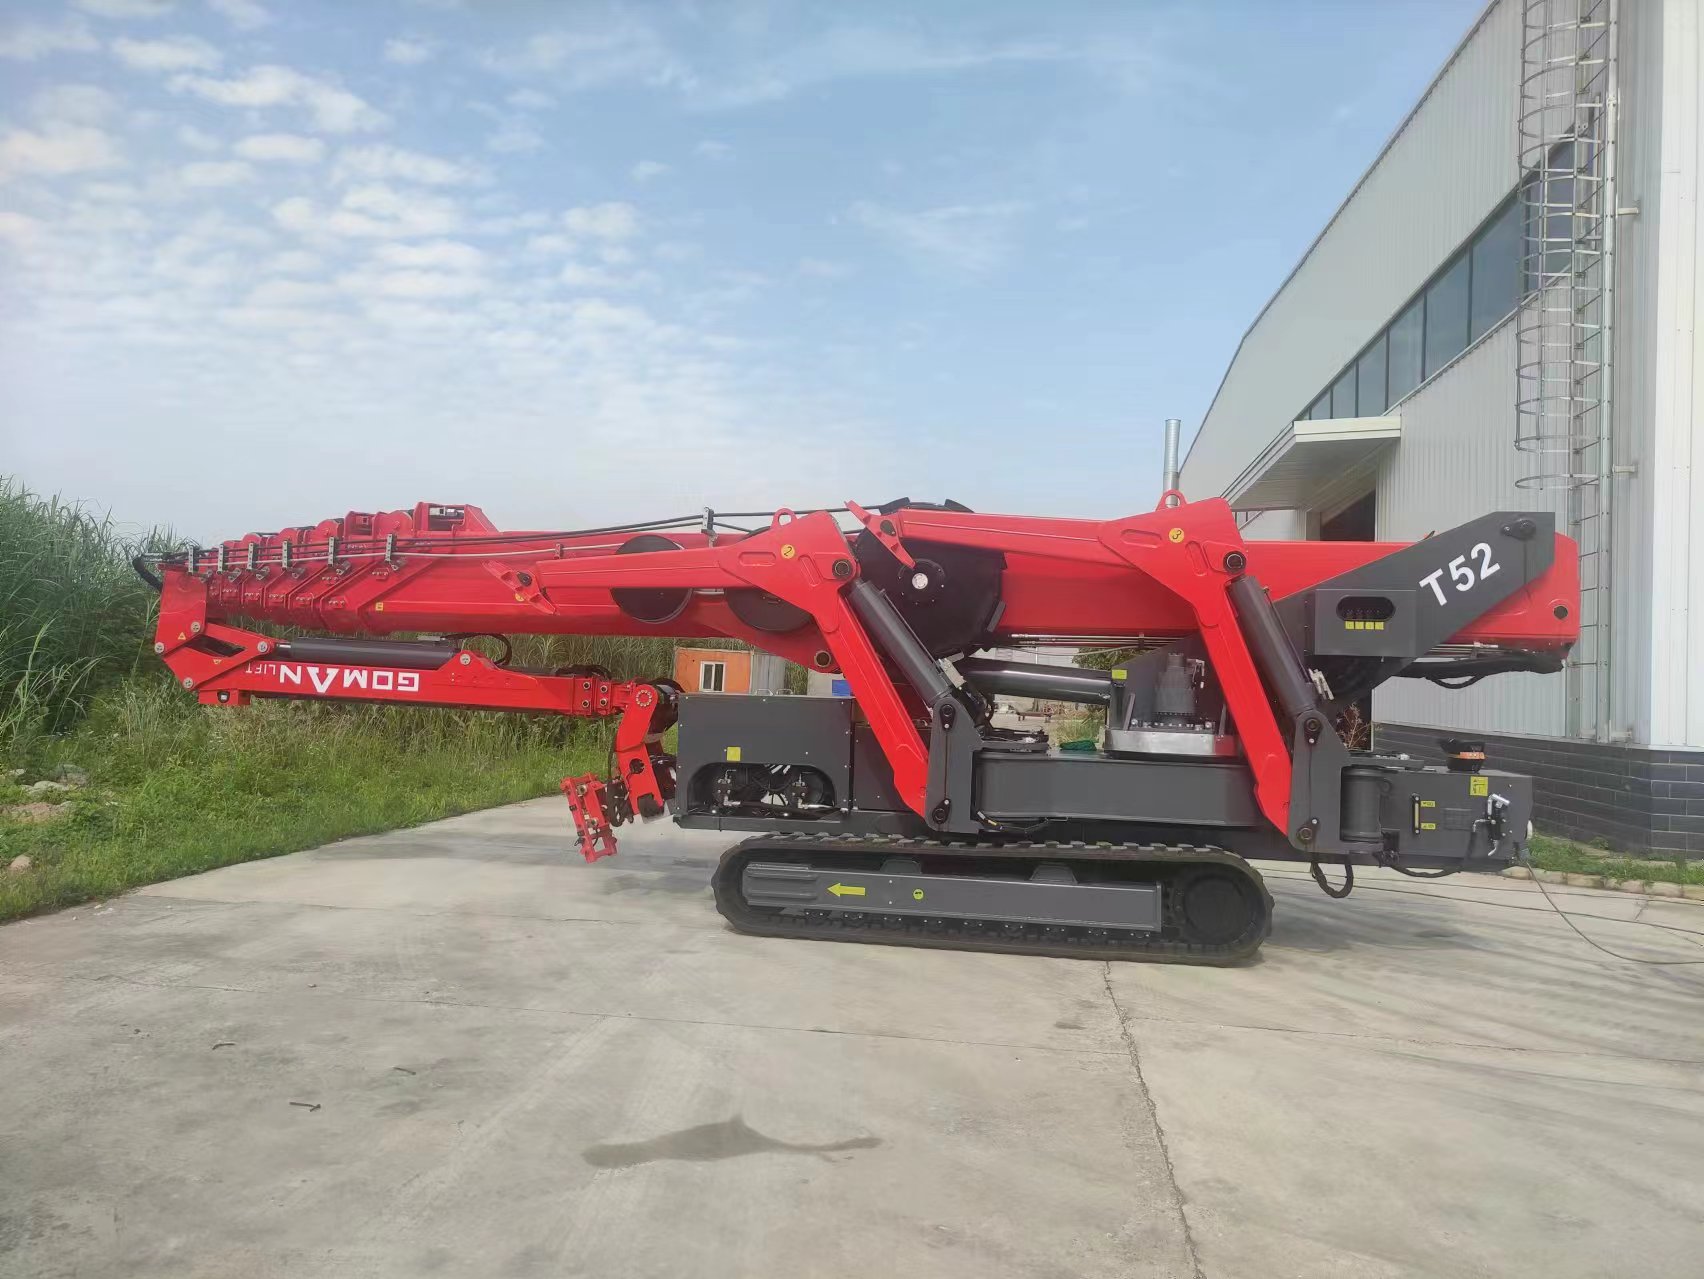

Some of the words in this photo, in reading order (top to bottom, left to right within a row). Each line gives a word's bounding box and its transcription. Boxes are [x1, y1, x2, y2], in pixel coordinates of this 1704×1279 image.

[1171, 529, 1183, 540] 3
[783, 545, 793, 557] 2
[1418, 542, 1501, 606] T52
[245, 663, 276, 675] LIFT
[279, 664, 420, 693] GOMAN
